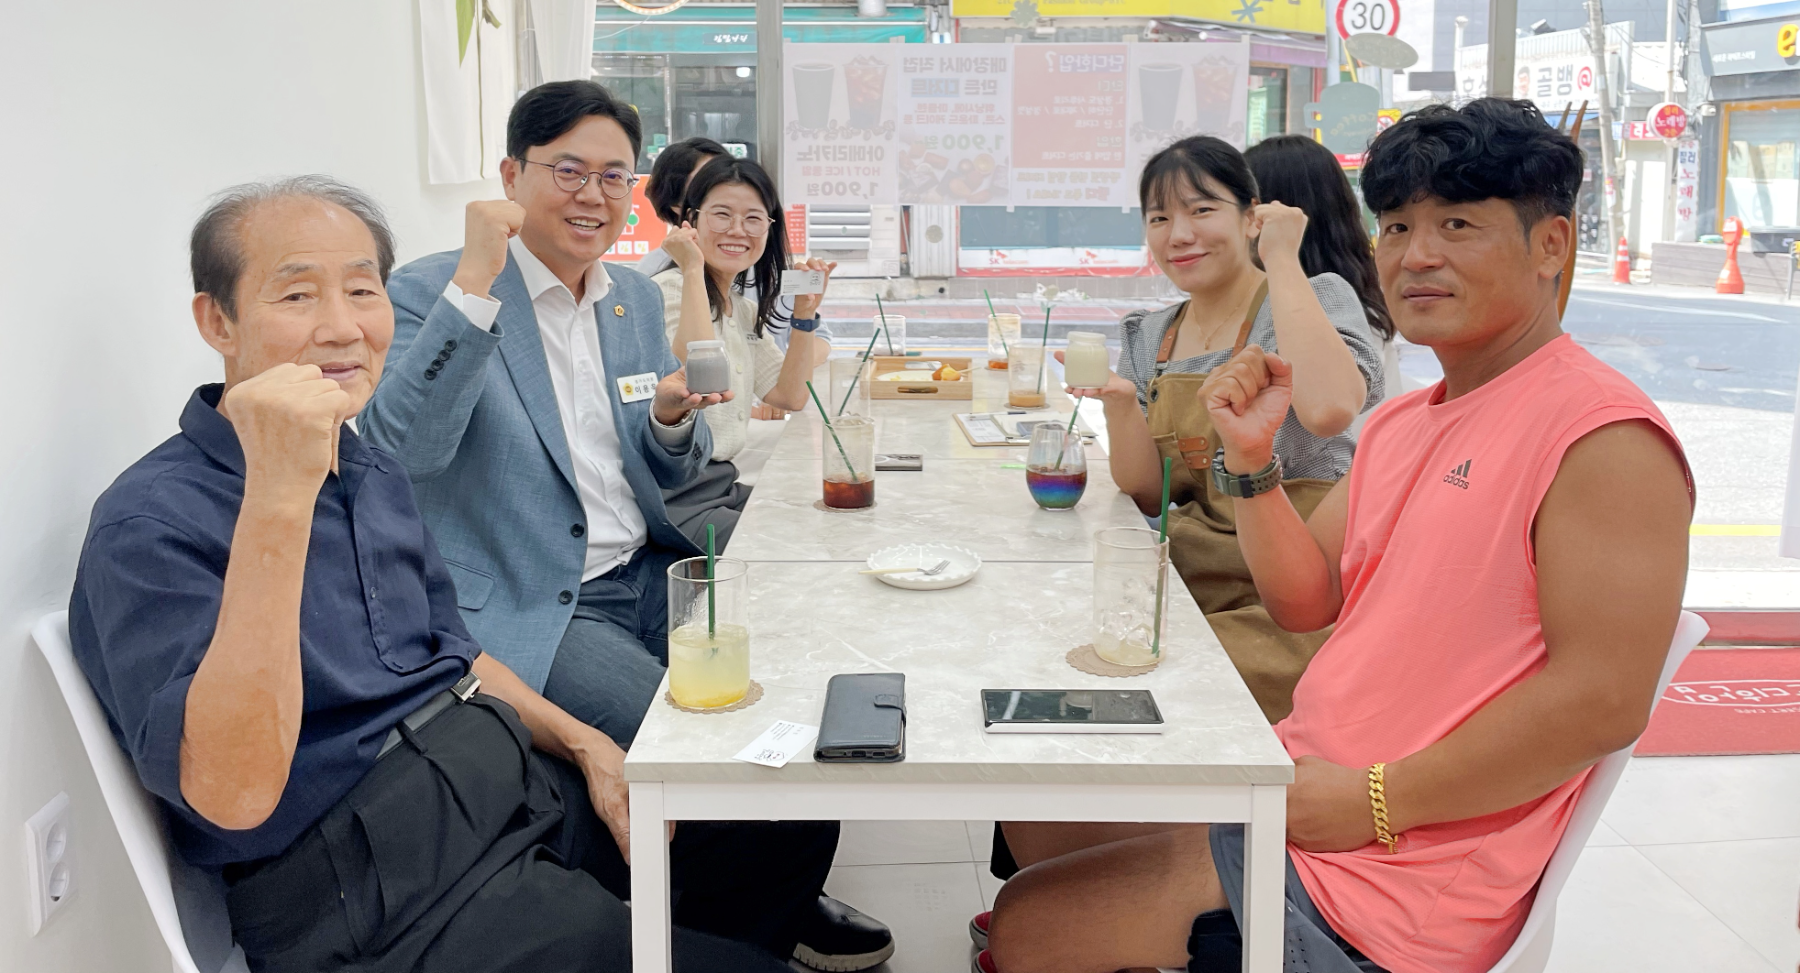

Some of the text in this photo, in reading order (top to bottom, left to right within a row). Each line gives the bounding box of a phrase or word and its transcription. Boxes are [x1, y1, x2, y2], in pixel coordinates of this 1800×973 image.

[1351, 2, 1385, 30] 30
[1656, 115, 1686, 128] 노래방
[1678, 168, 1696, 222] 노래방
[1443, 474, 1469, 490] adidas
